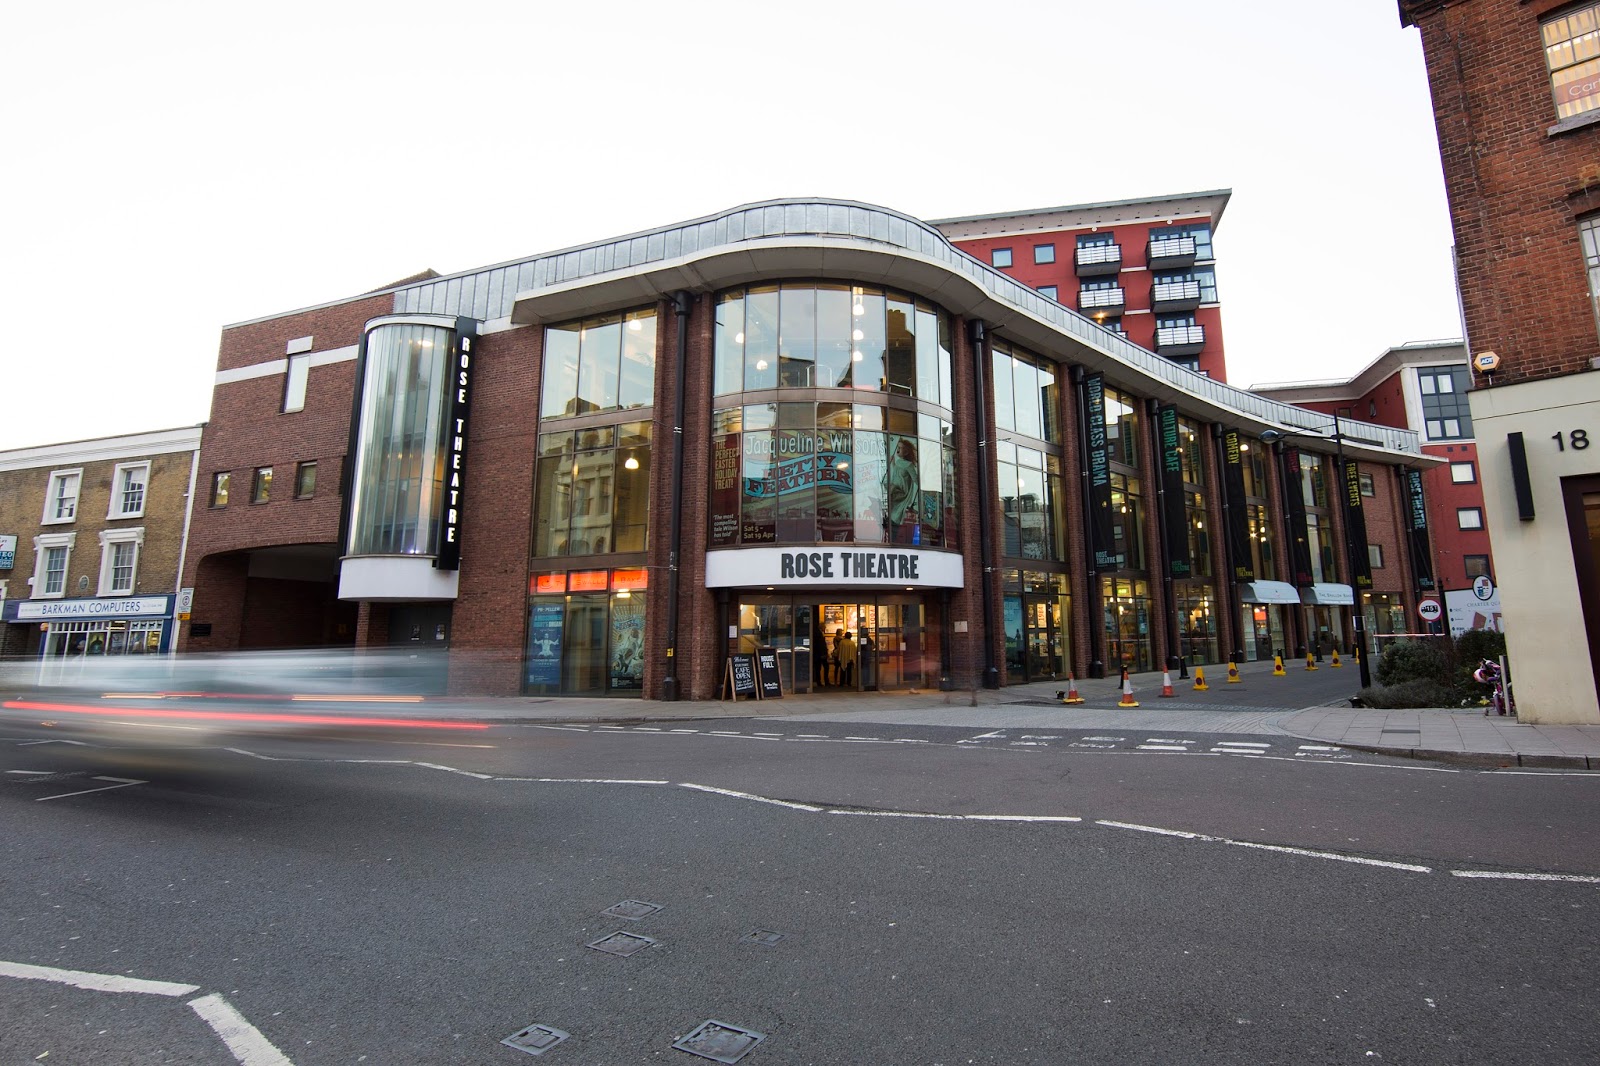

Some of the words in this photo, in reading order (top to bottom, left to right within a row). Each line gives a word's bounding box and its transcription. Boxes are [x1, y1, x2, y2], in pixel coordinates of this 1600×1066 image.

[1569, 77, 1600, 96] Car
[458, 336, 470, 404] ROSE
[1090, 415, 1104, 447] CLASS
[1161, 409, 1177, 448] CULTURE
[1552, 429, 1590, 451] 18
[715, 440, 726, 449] THE
[715, 448, 739, 459] PERFECT
[745, 432, 824, 459] Jacqueline
[1226, 432, 1240, 463] COMEDY
[715, 459, 736, 469] EASTER
[762, 455, 837, 479] HETTY
[1091, 450, 1107, 486] DRAMA
[1165, 449, 1179, 472] CAFE
[1345, 462, 1357, 480] FREE
[447, 418, 464, 542] THEATRE
[714, 468, 737, 479] HOLIDAY
[714, 478, 734, 490] TREAT!
[748, 469, 851, 495] FEATHER
[1408, 471, 1422, 493] ROSE
[1347, 480, 1360, 507] EVENTS
[1411, 493, 1426, 530] THEATRE
[762, 532, 774, 540] Apr
[781, 552, 834, 579] ROSE
[840, 552, 919, 579] THEATRE
[42, 603, 85, 615] BARKMAN
[88, 601, 141, 613] COMPUTERS
[763, 661, 775, 669] FULL
